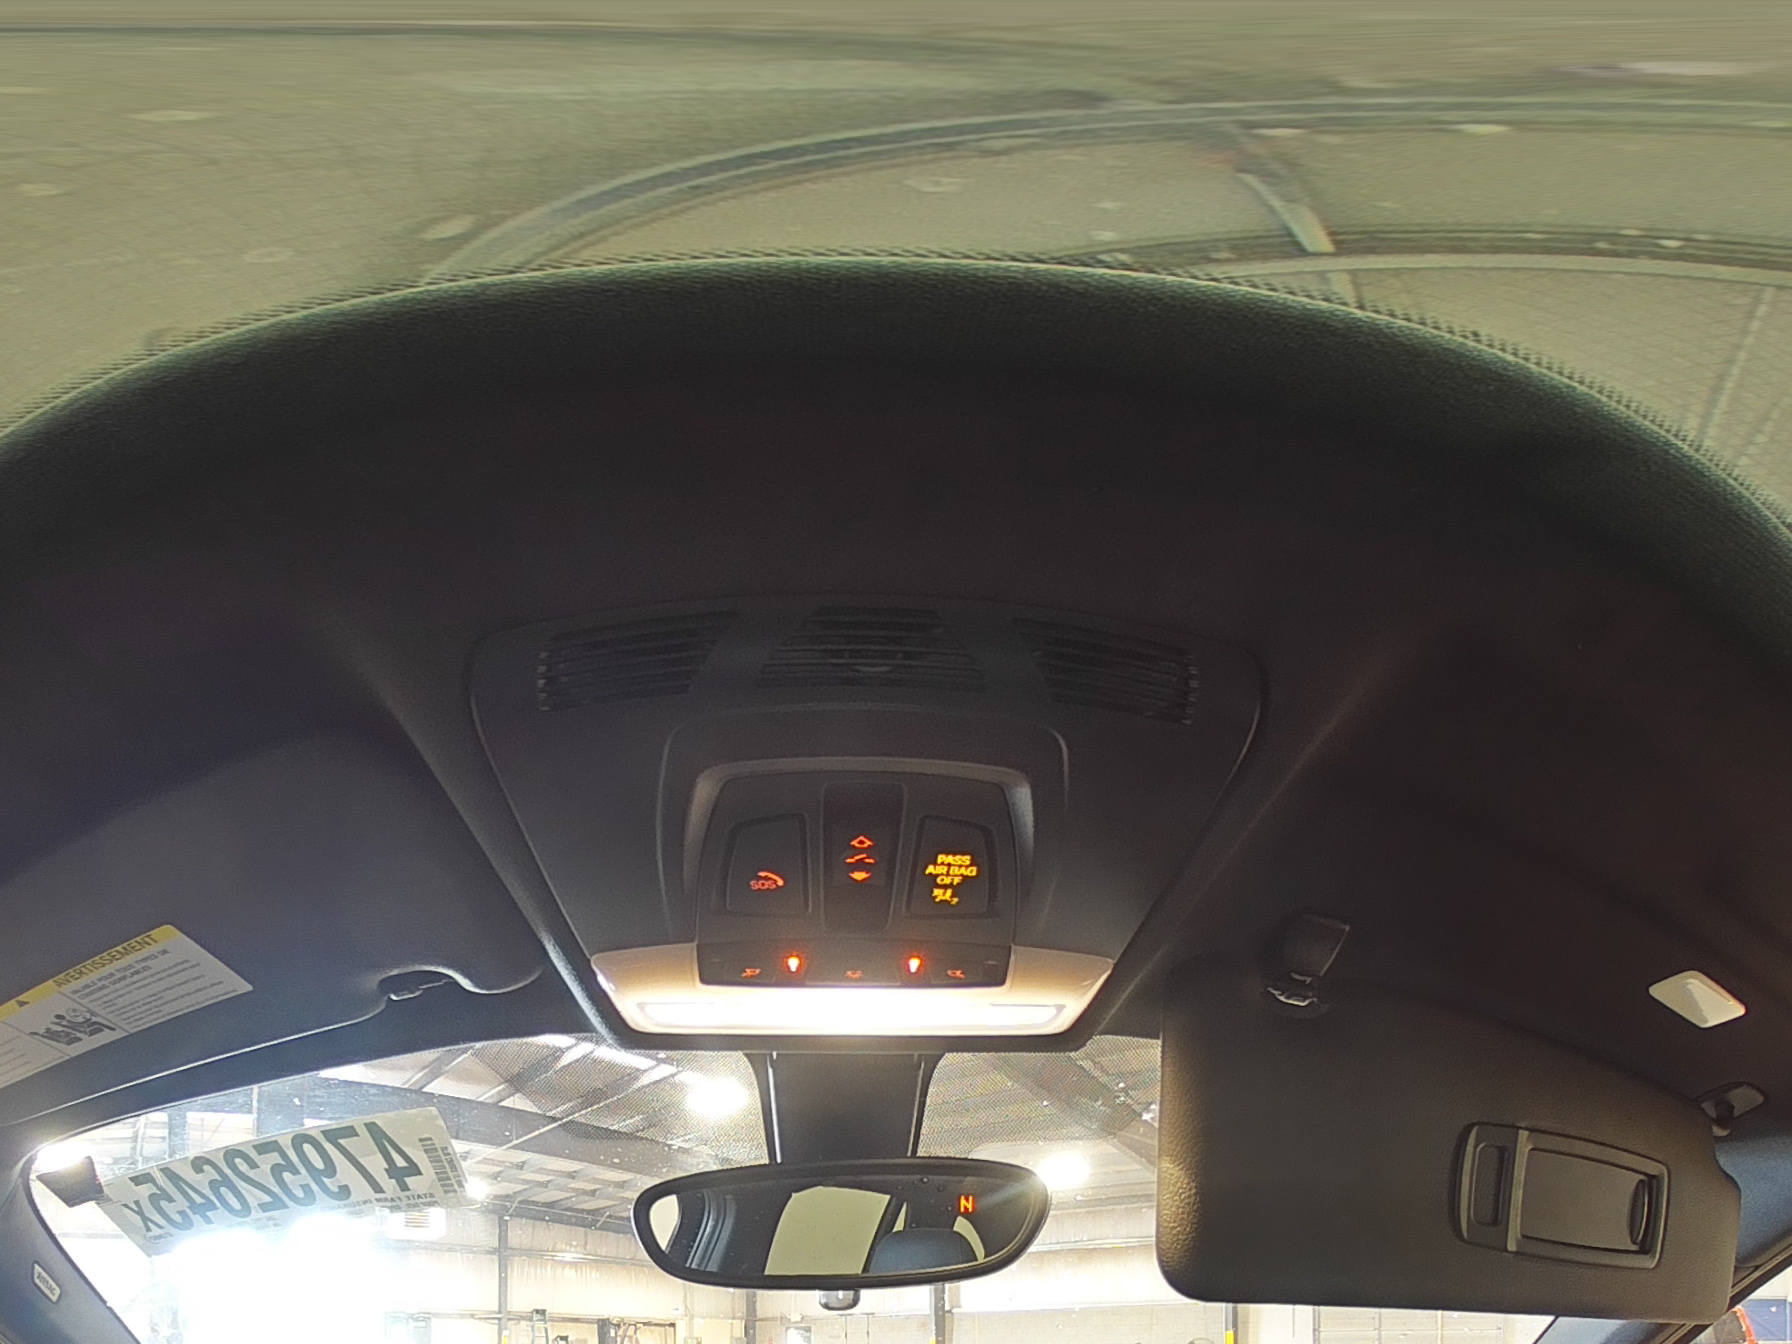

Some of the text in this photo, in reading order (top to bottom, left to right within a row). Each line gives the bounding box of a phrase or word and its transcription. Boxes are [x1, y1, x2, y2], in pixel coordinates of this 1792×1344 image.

[937, 854, 971, 865] PASS
[925, 865, 978, 876] AIR BAG
[750, 880, 777, 890] SOS
[936, 876, 963, 886] OFF
[52, 933, 158, 989] AVERTISSEMENT
[960, 1195, 973, 1213] N
